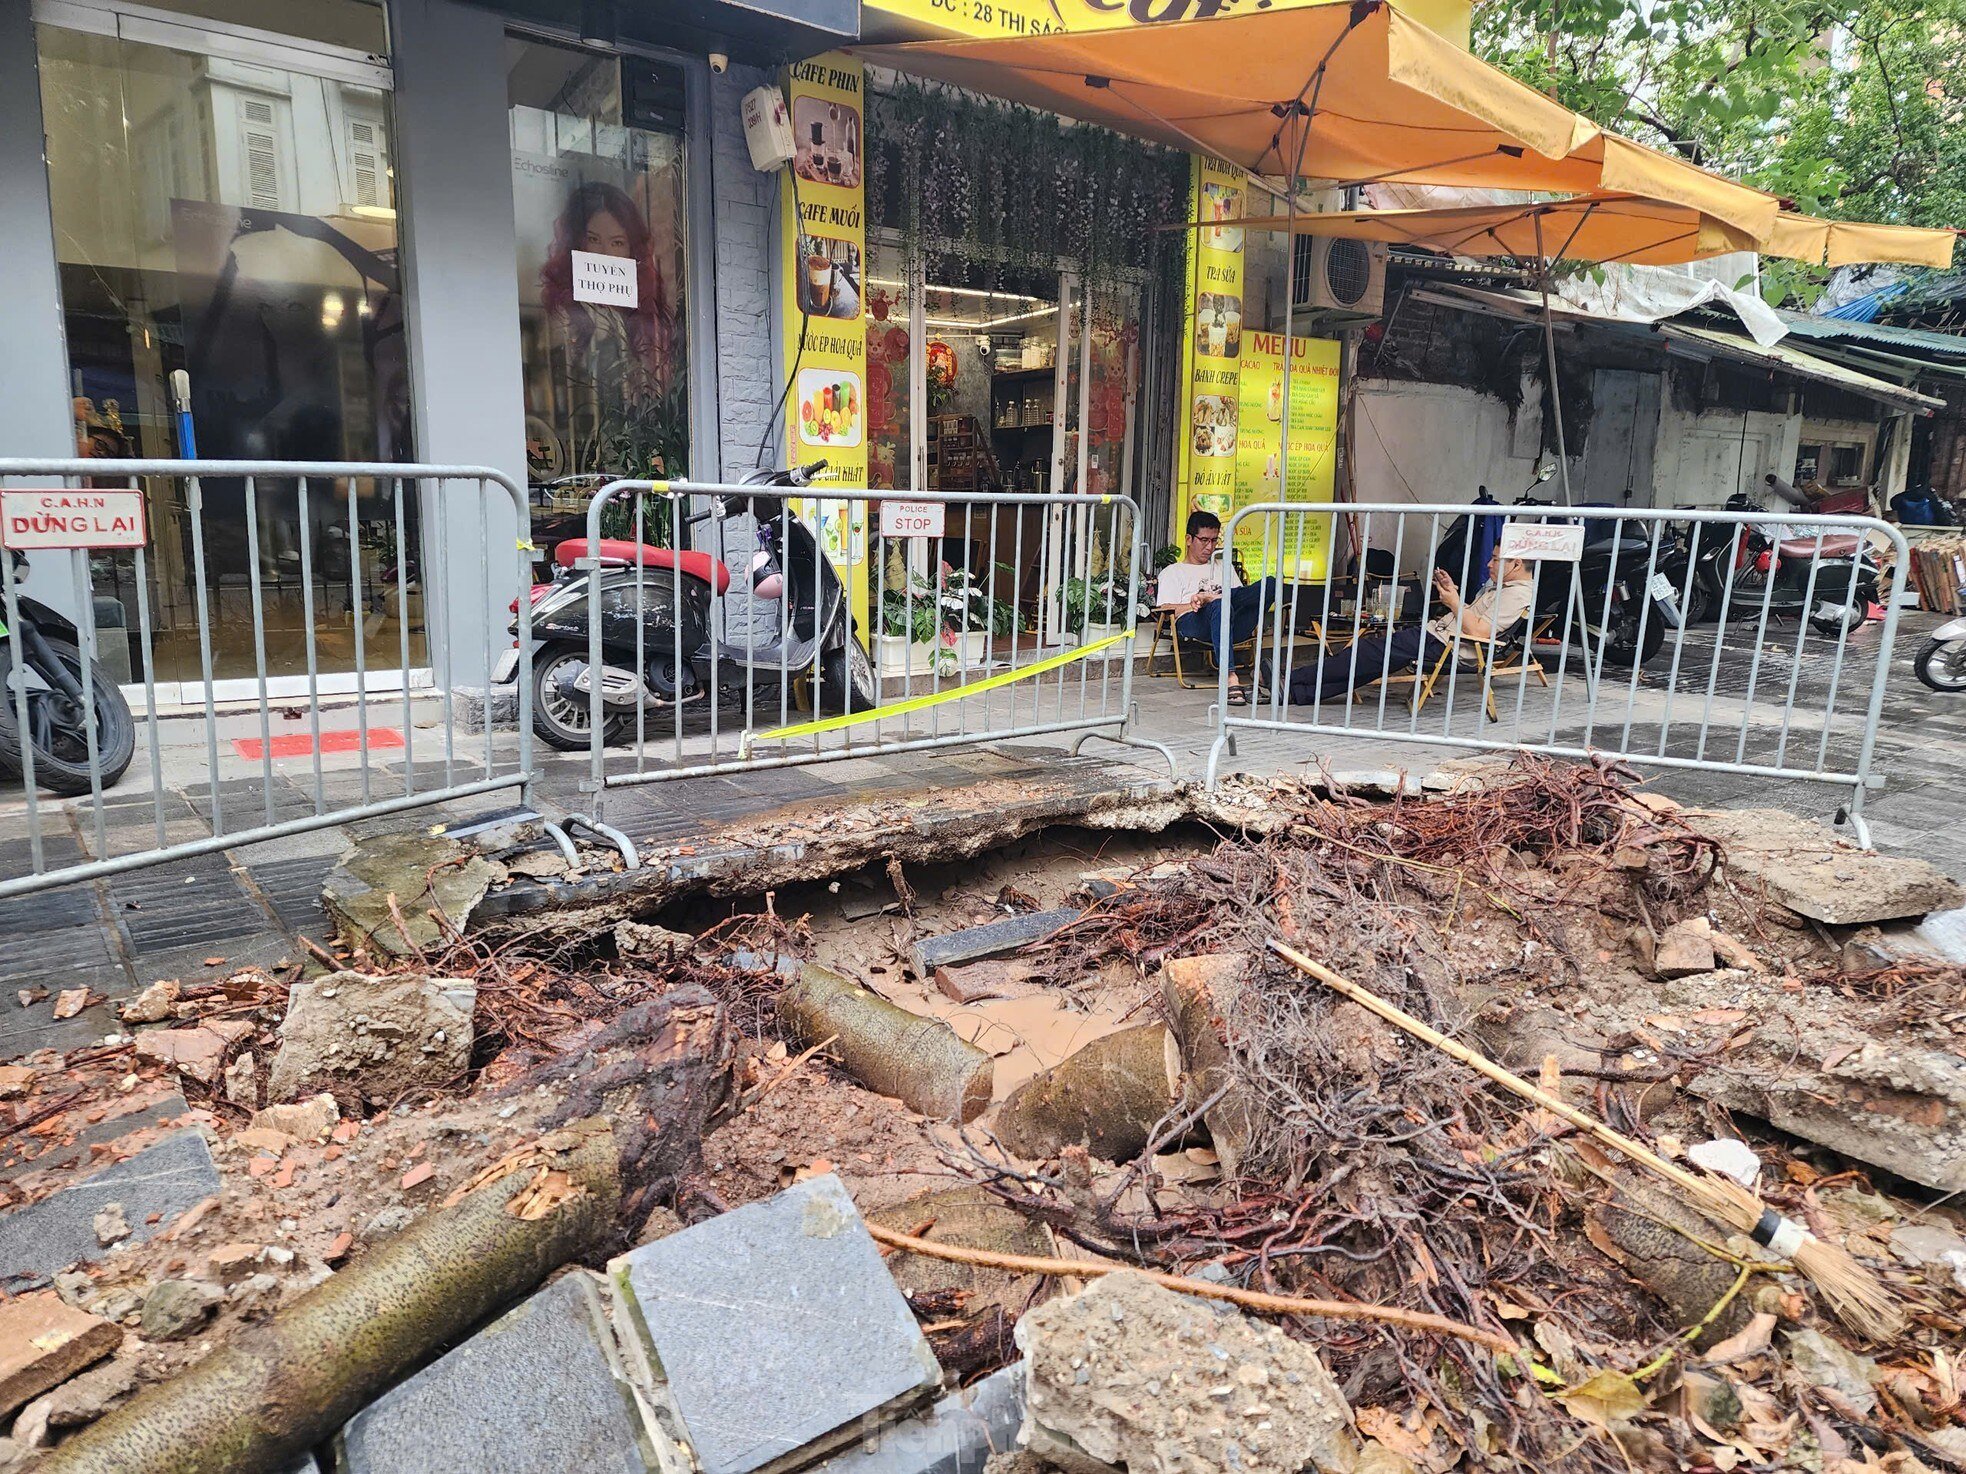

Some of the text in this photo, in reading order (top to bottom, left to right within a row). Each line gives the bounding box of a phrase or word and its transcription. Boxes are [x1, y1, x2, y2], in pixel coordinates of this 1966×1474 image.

[973, 2, 992, 23] 28
[998, 8, 1025, 34] THI
[791, 61, 860, 93] CAFE PHIN
[799, 201, 860, 228] CAFE MUỐI
[578, 278, 633, 298] THỢ PHỤ
[819, 331, 829, 352] ÉP
[830, 337, 846, 354] HOA
[847, 334, 862, 360] QUẢ
[1240, 360, 1260, 370] CACAO
[1195, 366, 1215, 383] BÁNH
[1216, 370, 1239, 385] CREPE
[1239, 438, 1265, 450] HOA QUẢ
[1295, 440, 1302, 451] ÉP
[1303, 442, 1315, 452] HOA
[842, 462, 863, 482] KHÁT
[40, 497, 105, 508] C.A.H.N
[899, 505, 928, 513] POLICE
[11, 511, 135, 536] DỪNG LẠI
[895, 517, 931, 530] STOP
[1240, 525, 1252, 536] SỮA
